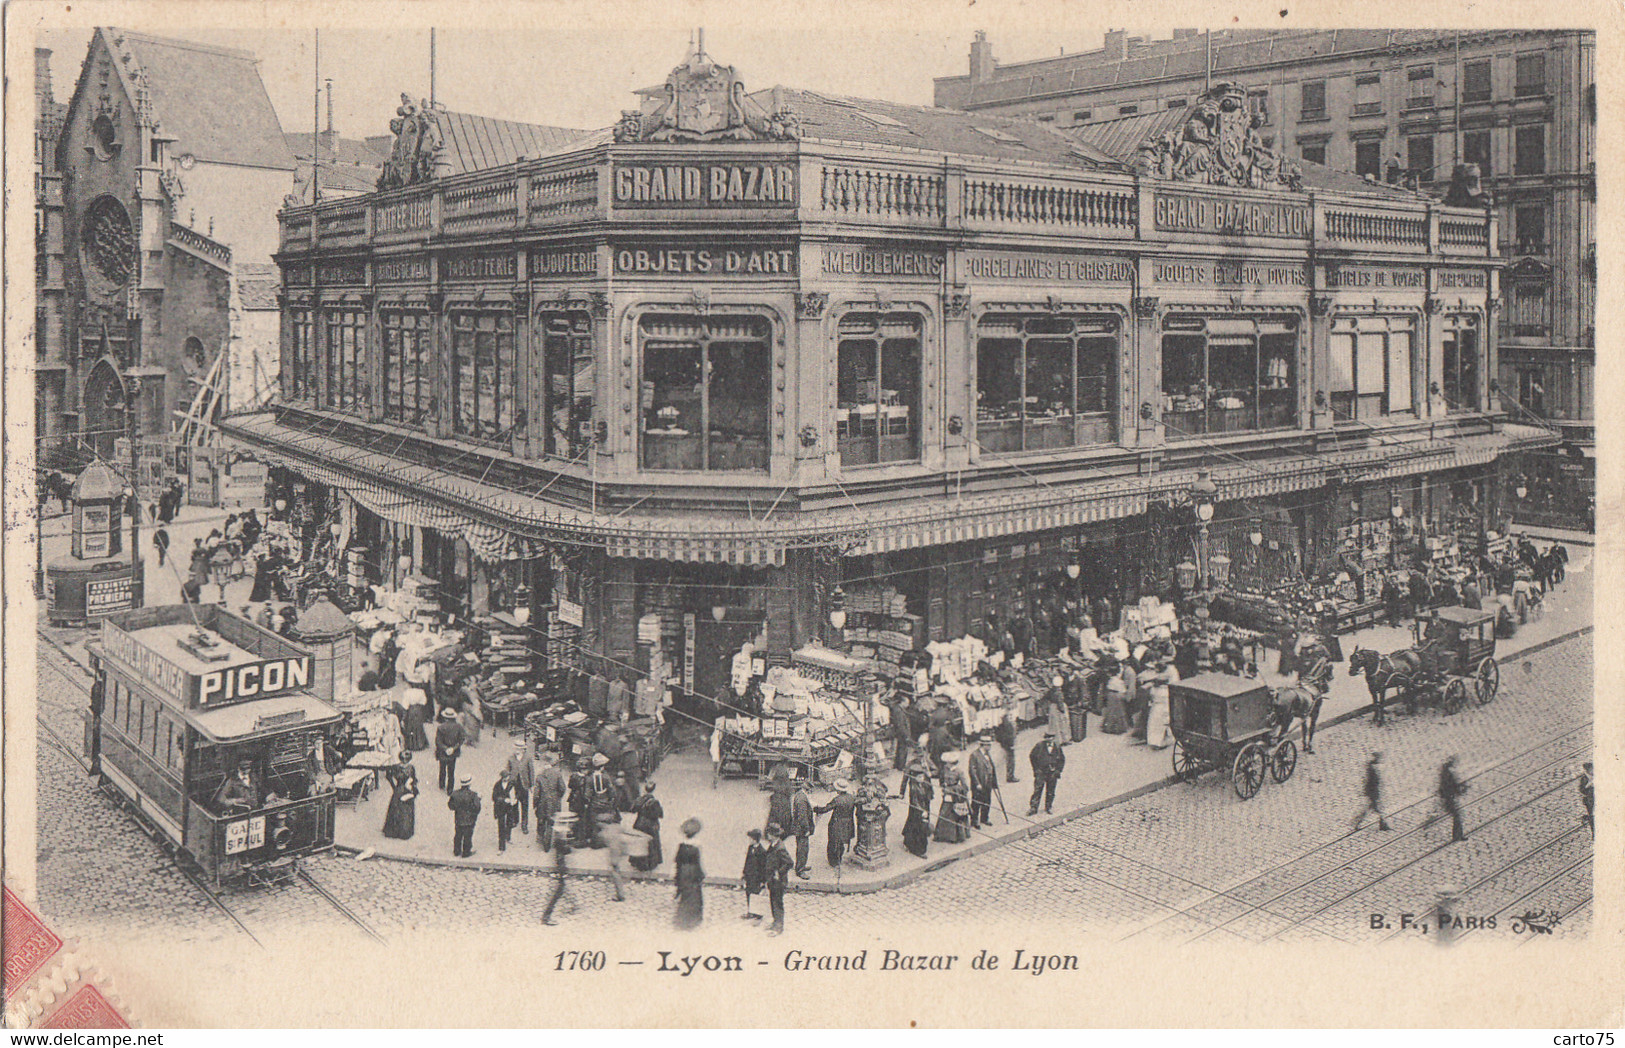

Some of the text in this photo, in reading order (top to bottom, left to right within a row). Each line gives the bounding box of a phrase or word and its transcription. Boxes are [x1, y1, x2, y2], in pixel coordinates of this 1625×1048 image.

[616, 166, 793, 201] GRAND BAZAR
[1155, 197, 1207, 229] GRAND
[1213, 203, 1260, 232] BAZAR
[1277, 210, 1312, 236] LYON
[448, 257, 514, 276] TABLETTERIE
[533, 252, 599, 273] BIJOUTERIE
[618, 250, 794, 274] OBJETS D'ART
[822, 249, 943, 276] AMEUBLEMENTS
[964, 257, 1134, 281] PORCELAINES ET CRISTAUX
[1154, 265, 1307, 286] JOUETS ET JEUX DIVERS
[199, 656, 309, 704] PICON
